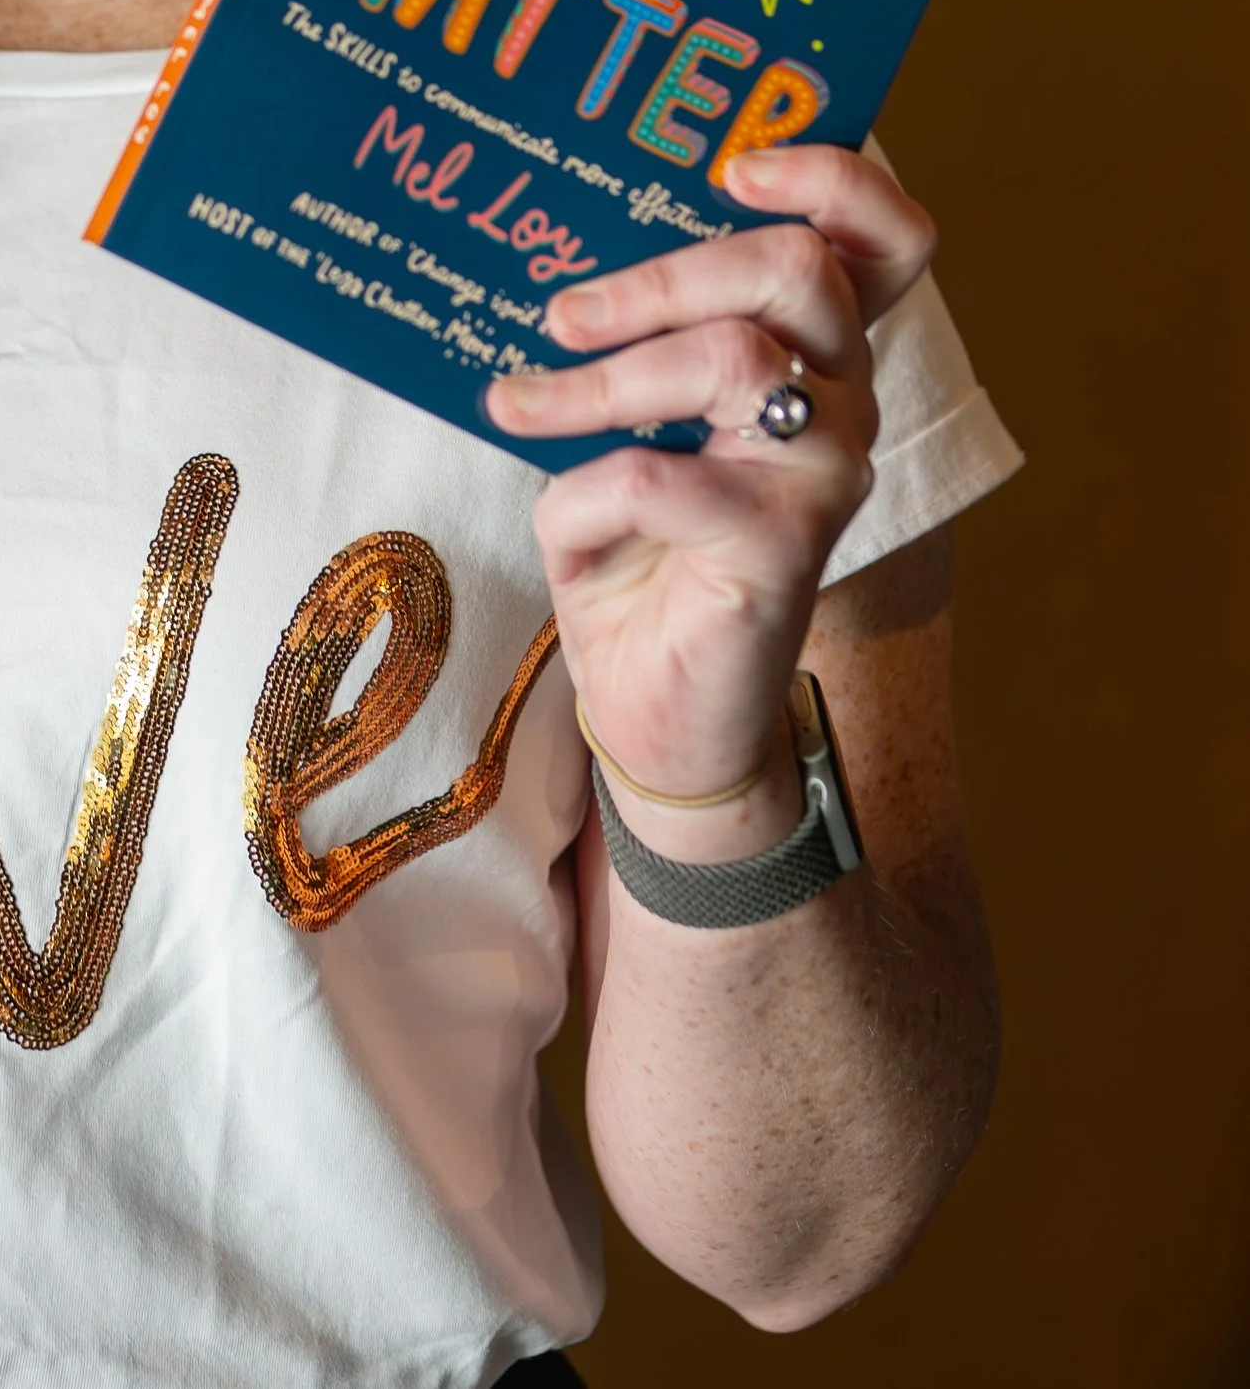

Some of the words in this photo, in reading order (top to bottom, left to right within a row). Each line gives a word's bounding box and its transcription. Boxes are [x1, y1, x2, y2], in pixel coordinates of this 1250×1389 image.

[134, 81, 171, 144] LOY
[283, 1, 323, 42] The
[324, 22, 398, 79] SKILLS
[397, 66, 423, 93] to
[424, 83, 560, 165] communicate
[561, 156, 624, 196] more
[188, 193, 254, 239] HOST
[276, 238, 311, 268] THE
[315, 251, 365, 298] 'Less
[364, 281, 441, 340] Chatter,
[442, 318, 497, 364] More
[290, 192, 379, 246] AUTHOR
[407, 242, 487, 307] 'Change
[355, 106, 474, 210] Mel
[467, 172, 597, 283] Loy
